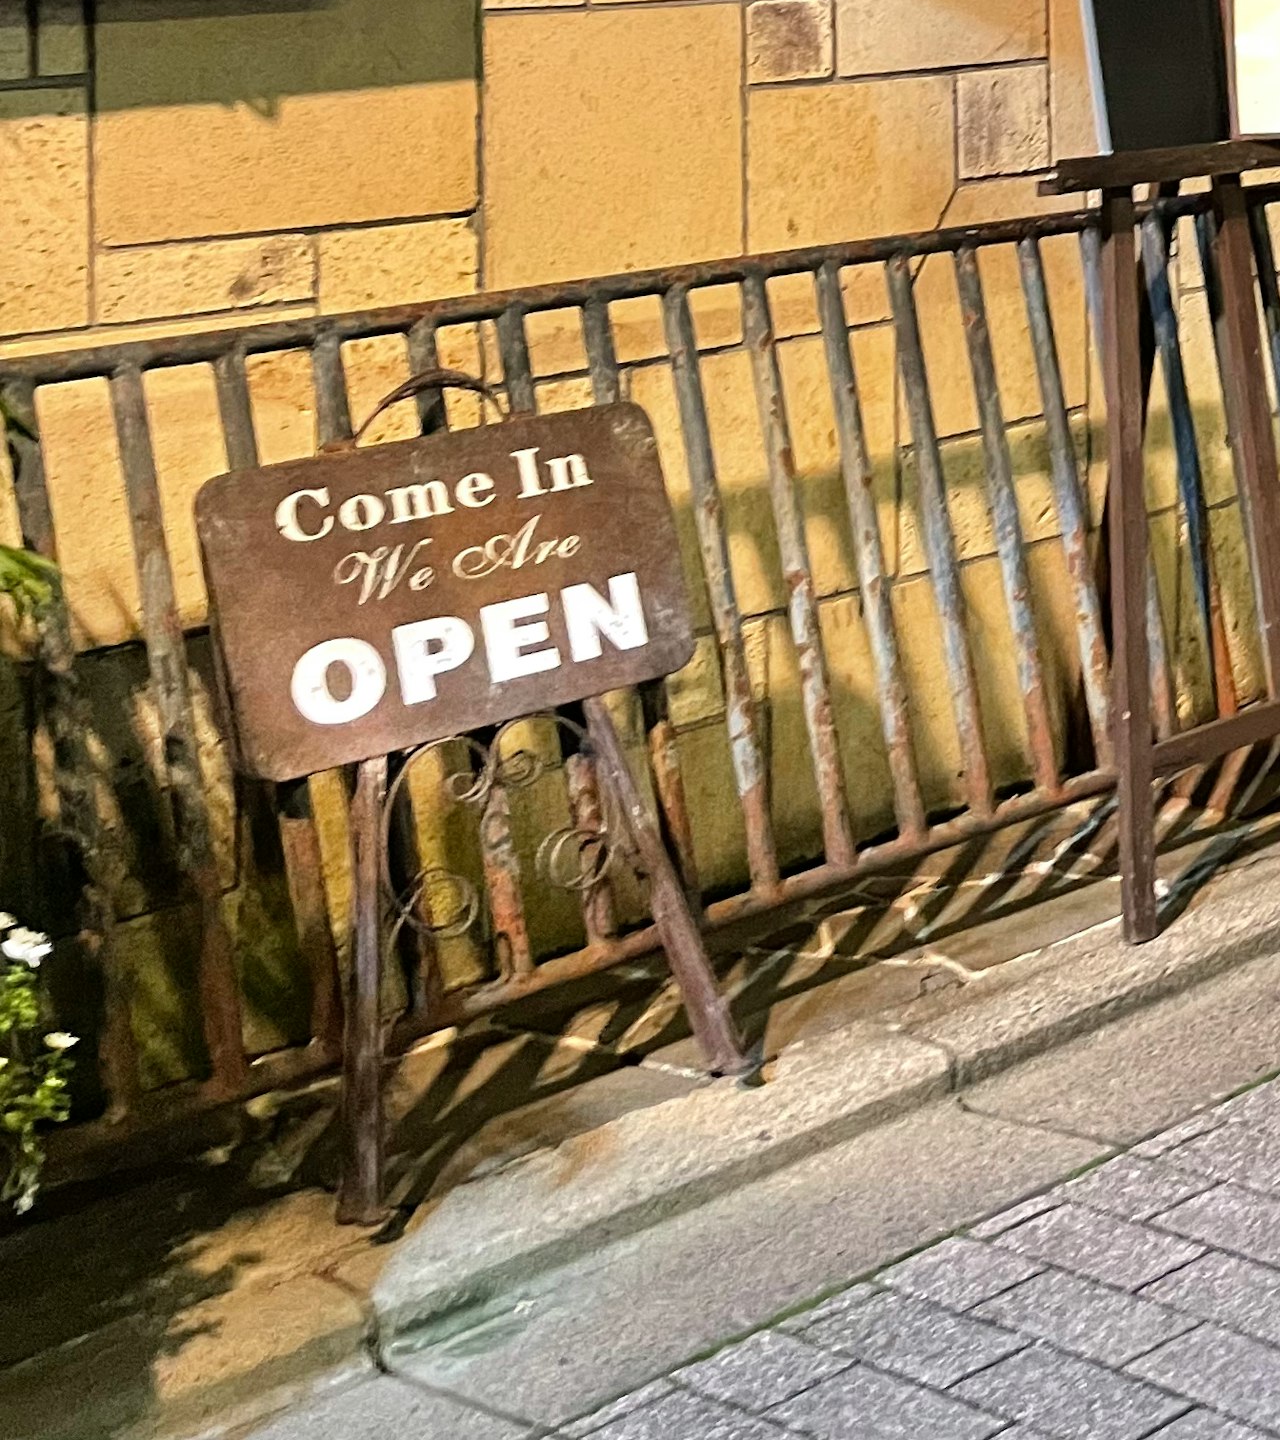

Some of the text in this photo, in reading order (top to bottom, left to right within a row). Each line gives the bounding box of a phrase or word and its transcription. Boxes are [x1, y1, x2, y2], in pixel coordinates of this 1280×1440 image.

[274, 446, 594, 543] Come In
[333, 514, 583, 606] We Are
[290, 571, 650, 726] OPEN
